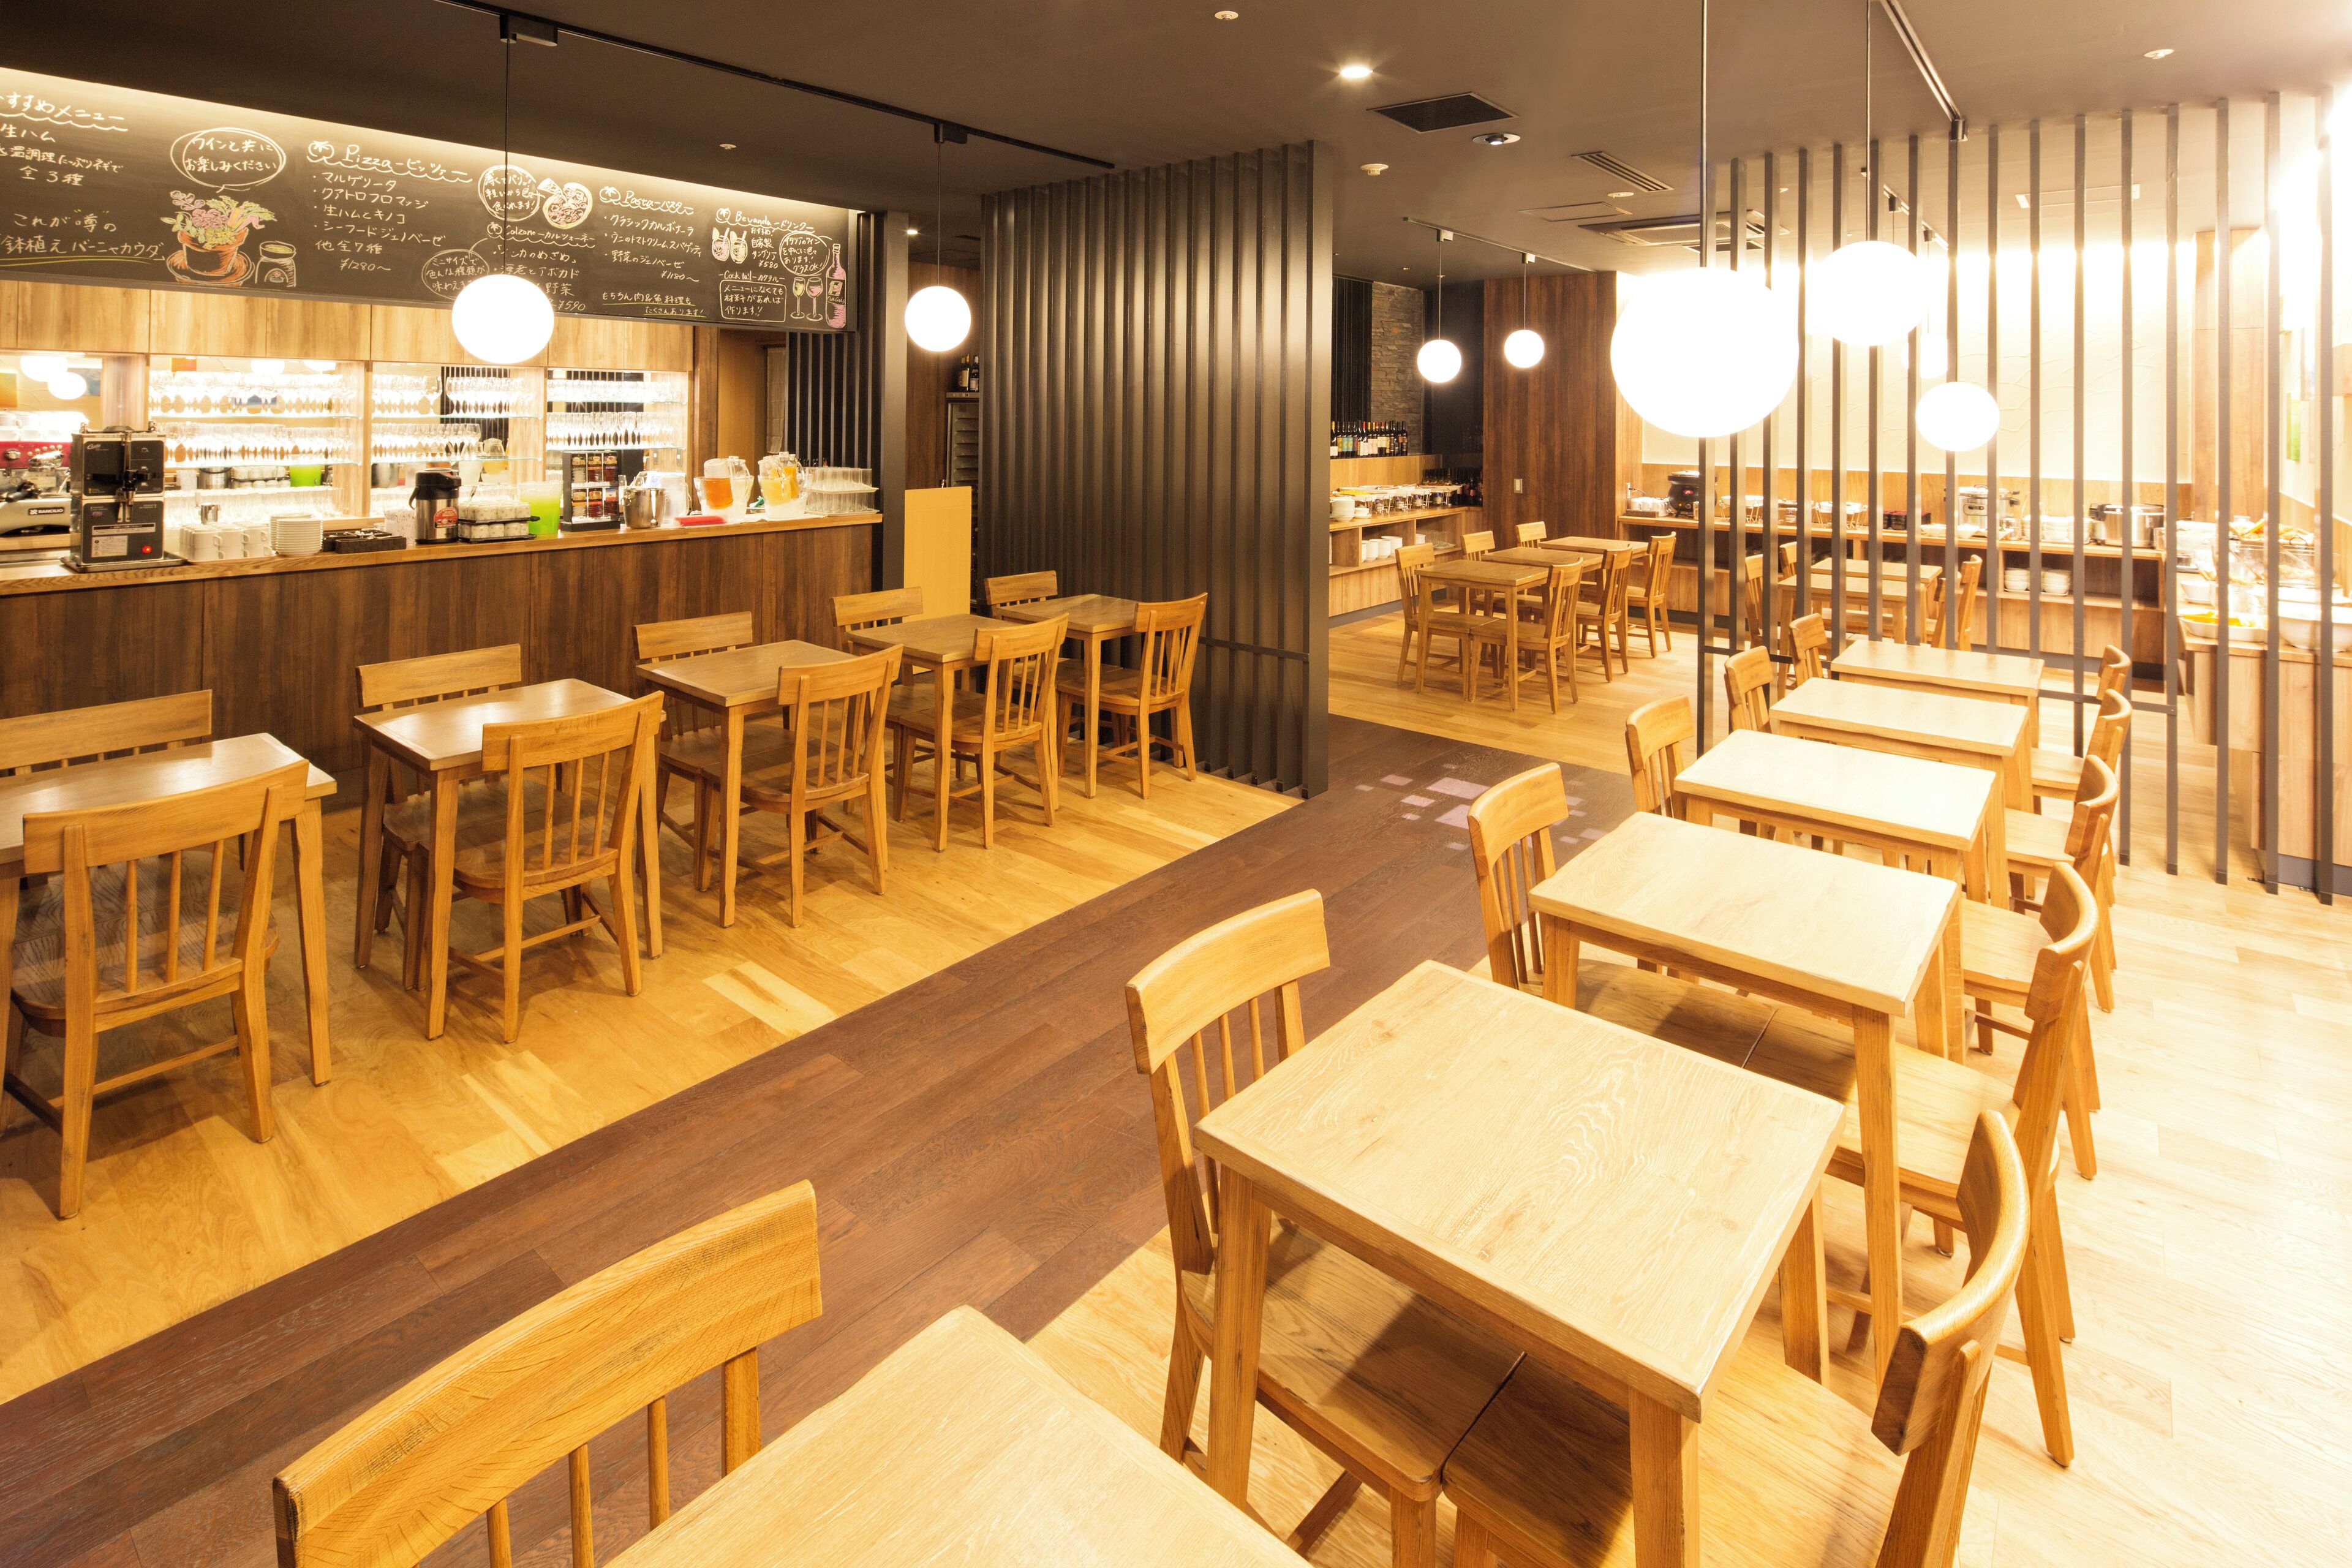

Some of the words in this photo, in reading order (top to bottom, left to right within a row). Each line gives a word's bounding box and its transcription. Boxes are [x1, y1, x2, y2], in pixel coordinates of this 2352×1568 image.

[0, 92, 124, 120] すすめメニュー
[0, 124, 56, 142] 生ハム
[192, 137, 273, 153] ワインと共に
[342, 145, 392, 168] Pizza
[185, 156, 277, 173] お楽しみください
[735, 211, 772, 226] Bevanda
[752, 238, 774, 249] 自家製
[785, 237, 821, 246] イタリアのワイン
[752, 250, 777, 260] サングリア
[759, 260, 778, 269] ¥580
